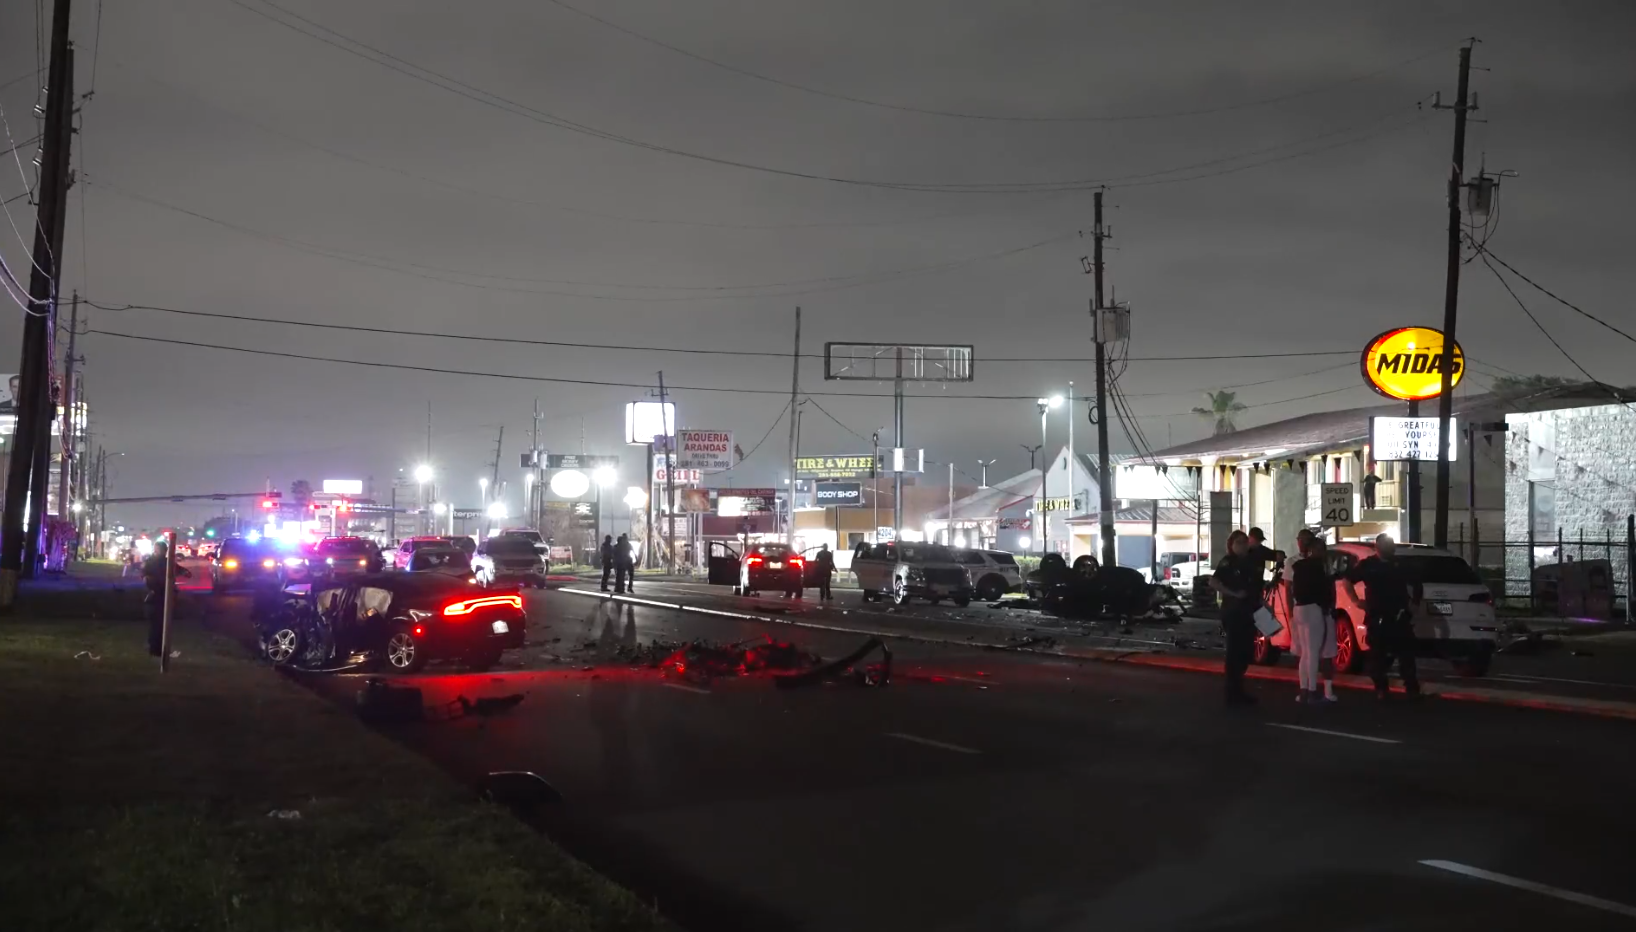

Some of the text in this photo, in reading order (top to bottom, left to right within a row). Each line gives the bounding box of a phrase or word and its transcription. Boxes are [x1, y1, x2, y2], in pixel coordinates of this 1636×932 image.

[1377, 354, 1462, 376] MIDAS
[681, 432, 729, 443] TAQUERIA
[684, 443, 727, 452] ARANDAS
[795, 457, 825, 469] TIRE
[826, 459, 835, 468] &
[817, 490, 859, 498] BODY SHOP
[1327, 497, 1345, 505] LIMIT
[1325, 507, 1349, 522] 40
